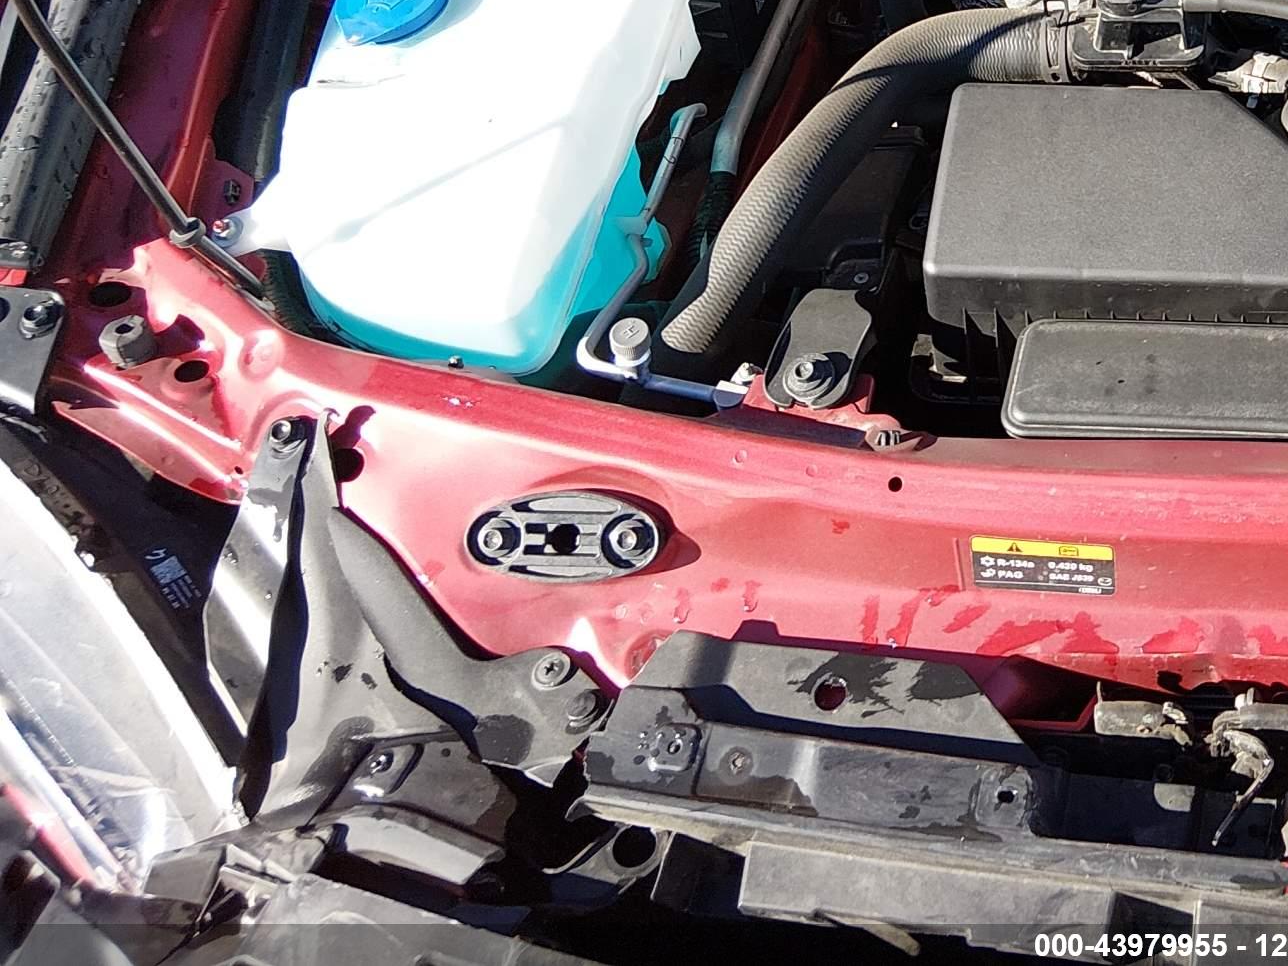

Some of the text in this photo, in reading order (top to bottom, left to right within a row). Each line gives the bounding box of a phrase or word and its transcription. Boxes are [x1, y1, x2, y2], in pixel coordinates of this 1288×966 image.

[996, 558, 1035, 568] R-134a
[1078, 562, 1094, 572] kg
[997, 570, 1024, 579] PAG
